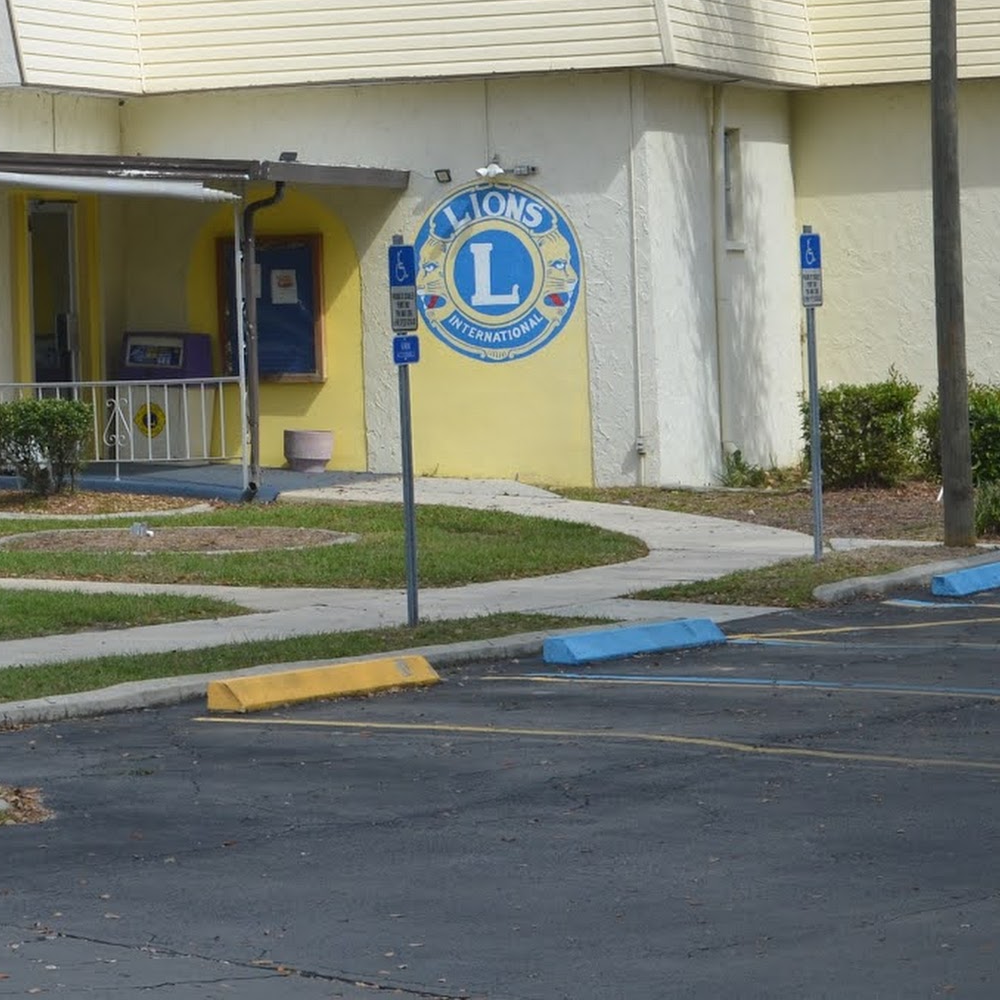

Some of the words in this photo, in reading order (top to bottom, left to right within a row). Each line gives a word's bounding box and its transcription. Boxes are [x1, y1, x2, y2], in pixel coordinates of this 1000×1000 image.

[442, 191, 544, 229] LIONS
[470, 243, 520, 306] L
[448, 313, 544, 343] INTERNATIONAL
